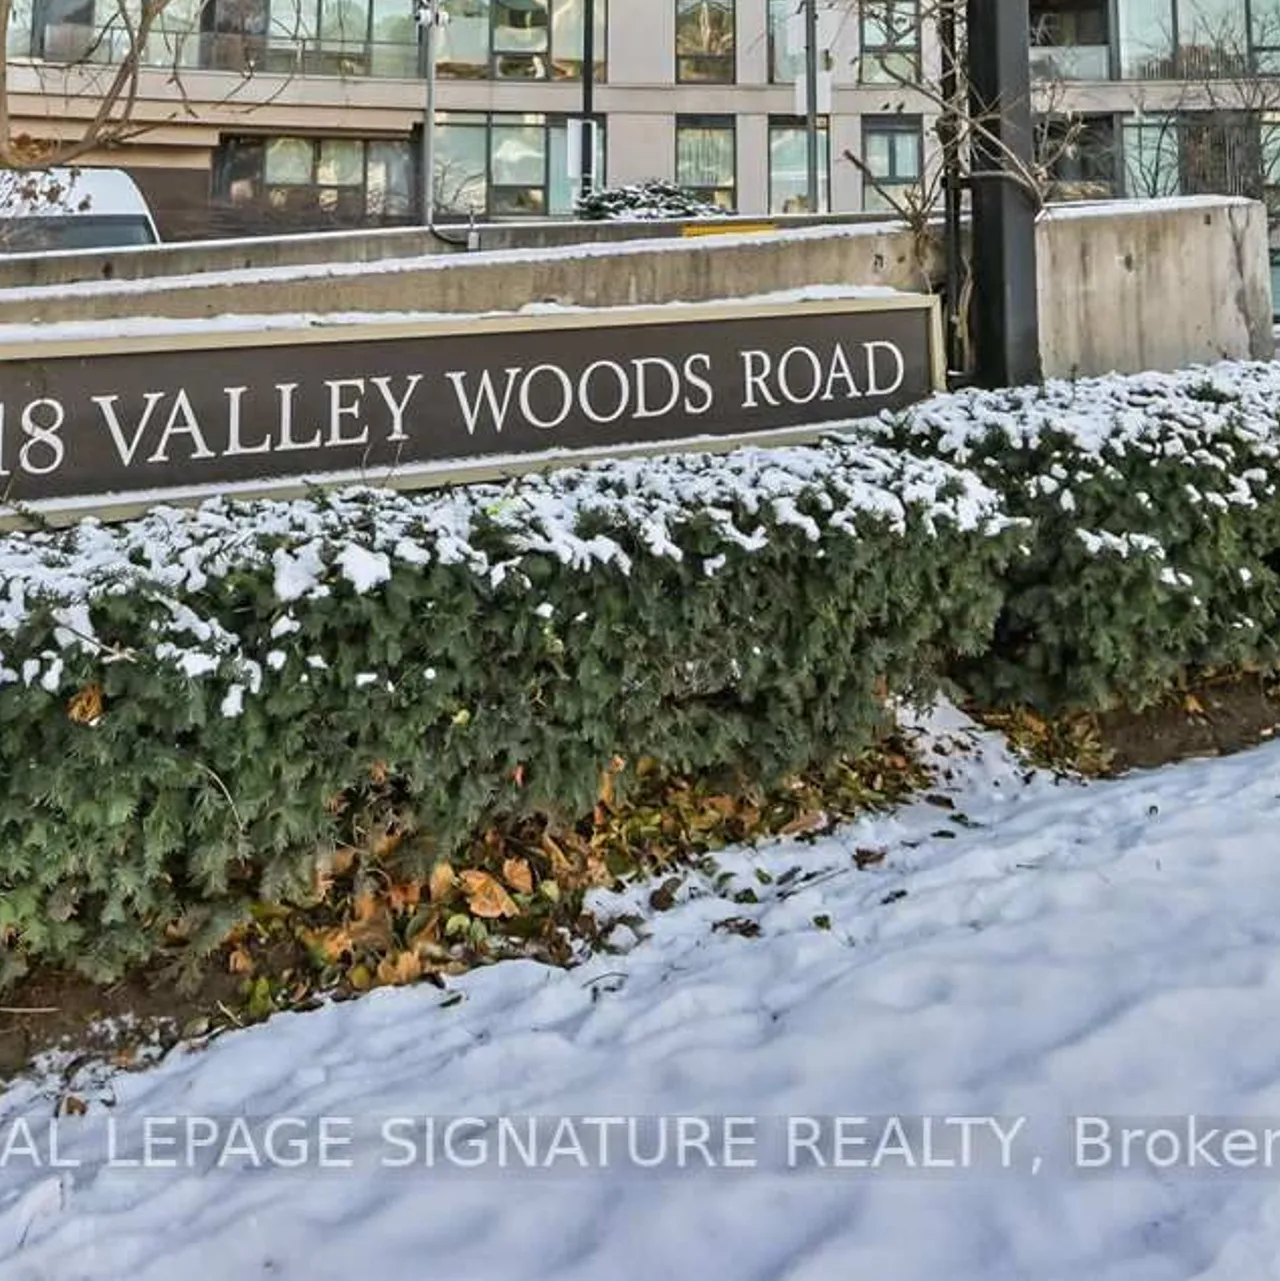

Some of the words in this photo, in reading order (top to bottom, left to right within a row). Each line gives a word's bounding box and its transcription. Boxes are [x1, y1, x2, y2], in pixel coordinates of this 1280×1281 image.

[90, 373, 425, 468] VALLEY
[444, 352, 714, 436] WOODS
[740, 339, 906, 409] ROAD
